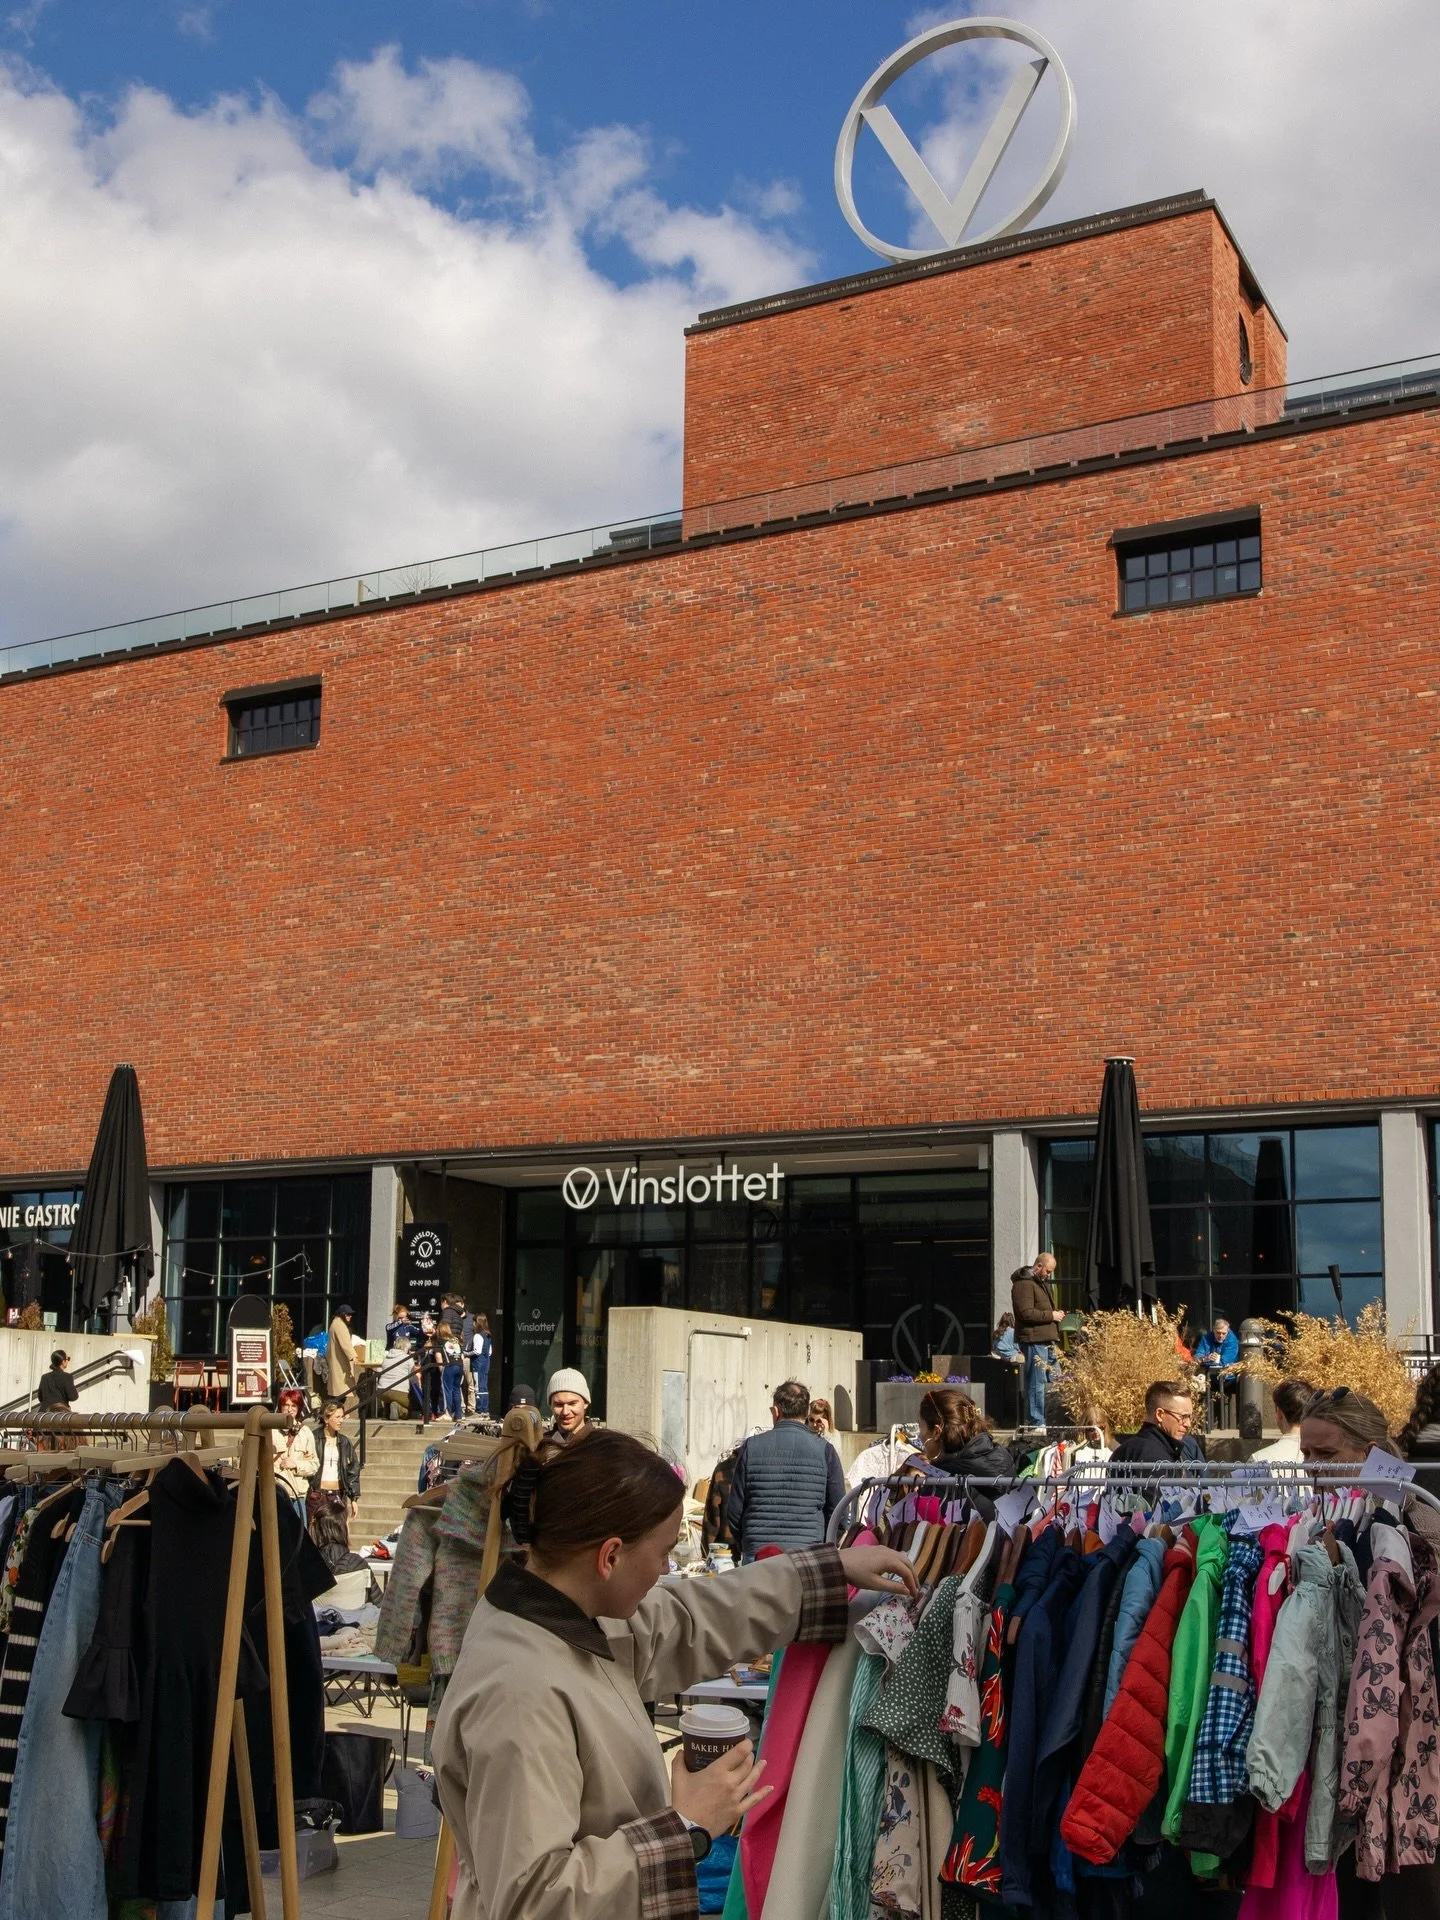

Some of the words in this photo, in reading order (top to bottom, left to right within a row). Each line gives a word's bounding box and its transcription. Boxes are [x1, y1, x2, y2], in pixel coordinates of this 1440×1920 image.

[605, 1162, 785, 1206] Vinslottet
[410, 1230, 441, 1247] VINSLOTTET
[415, 1259, 435, 1268] HASLE
[517, 1322, 556, 1332] Vinslottet
[691, 1741, 719, 1753] BAKER
